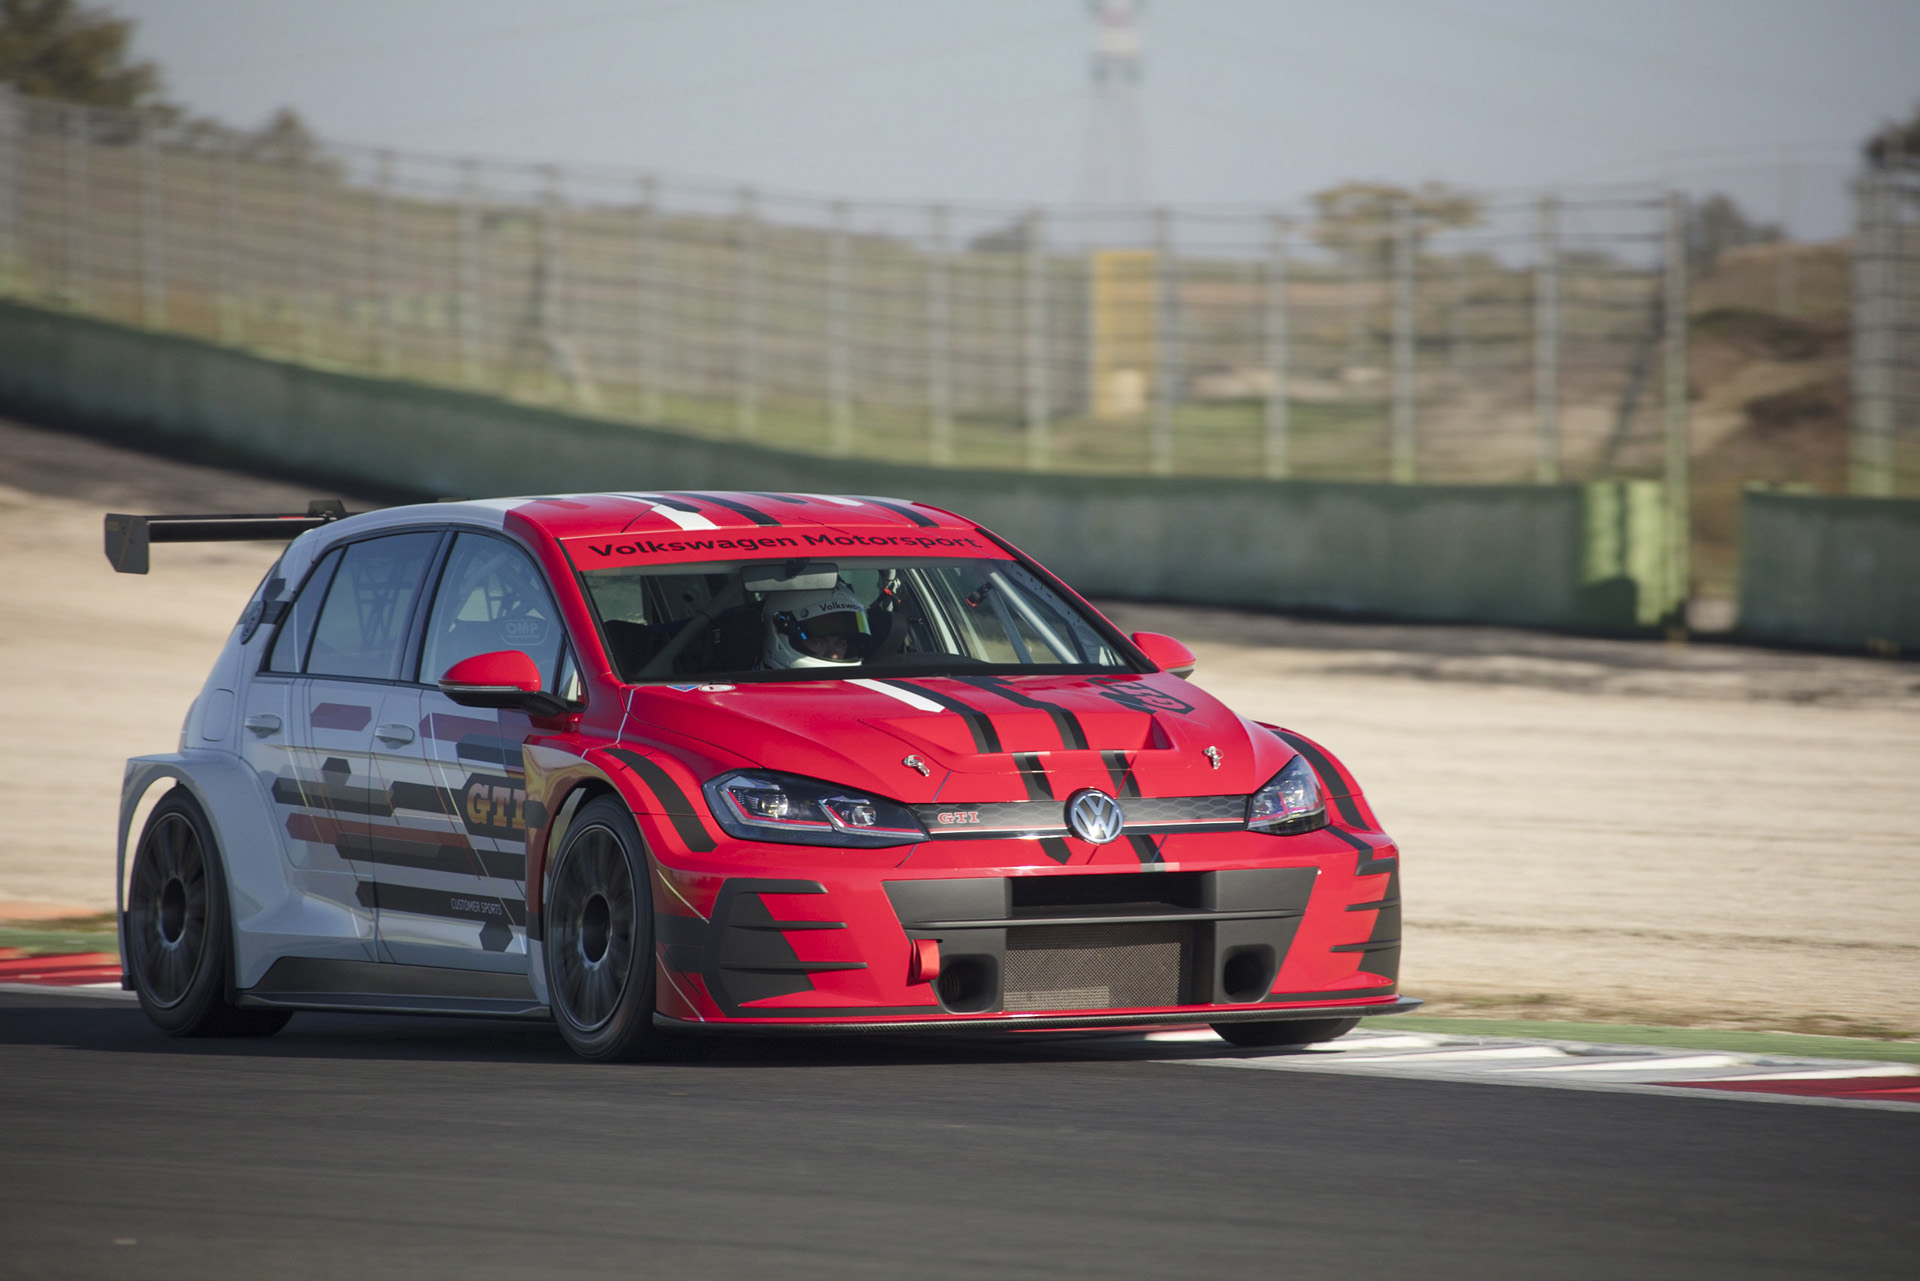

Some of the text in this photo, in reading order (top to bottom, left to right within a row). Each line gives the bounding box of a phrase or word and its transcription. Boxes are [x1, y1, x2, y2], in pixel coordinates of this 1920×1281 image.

[589, 534, 982, 556] Volkswagen Motorsport
[506, 622, 539, 634] OMP
[466, 782, 526, 830] GTI
[937, 811, 980, 824] GTI
[451, 898, 503, 915] CUSTOMER SPORTS
